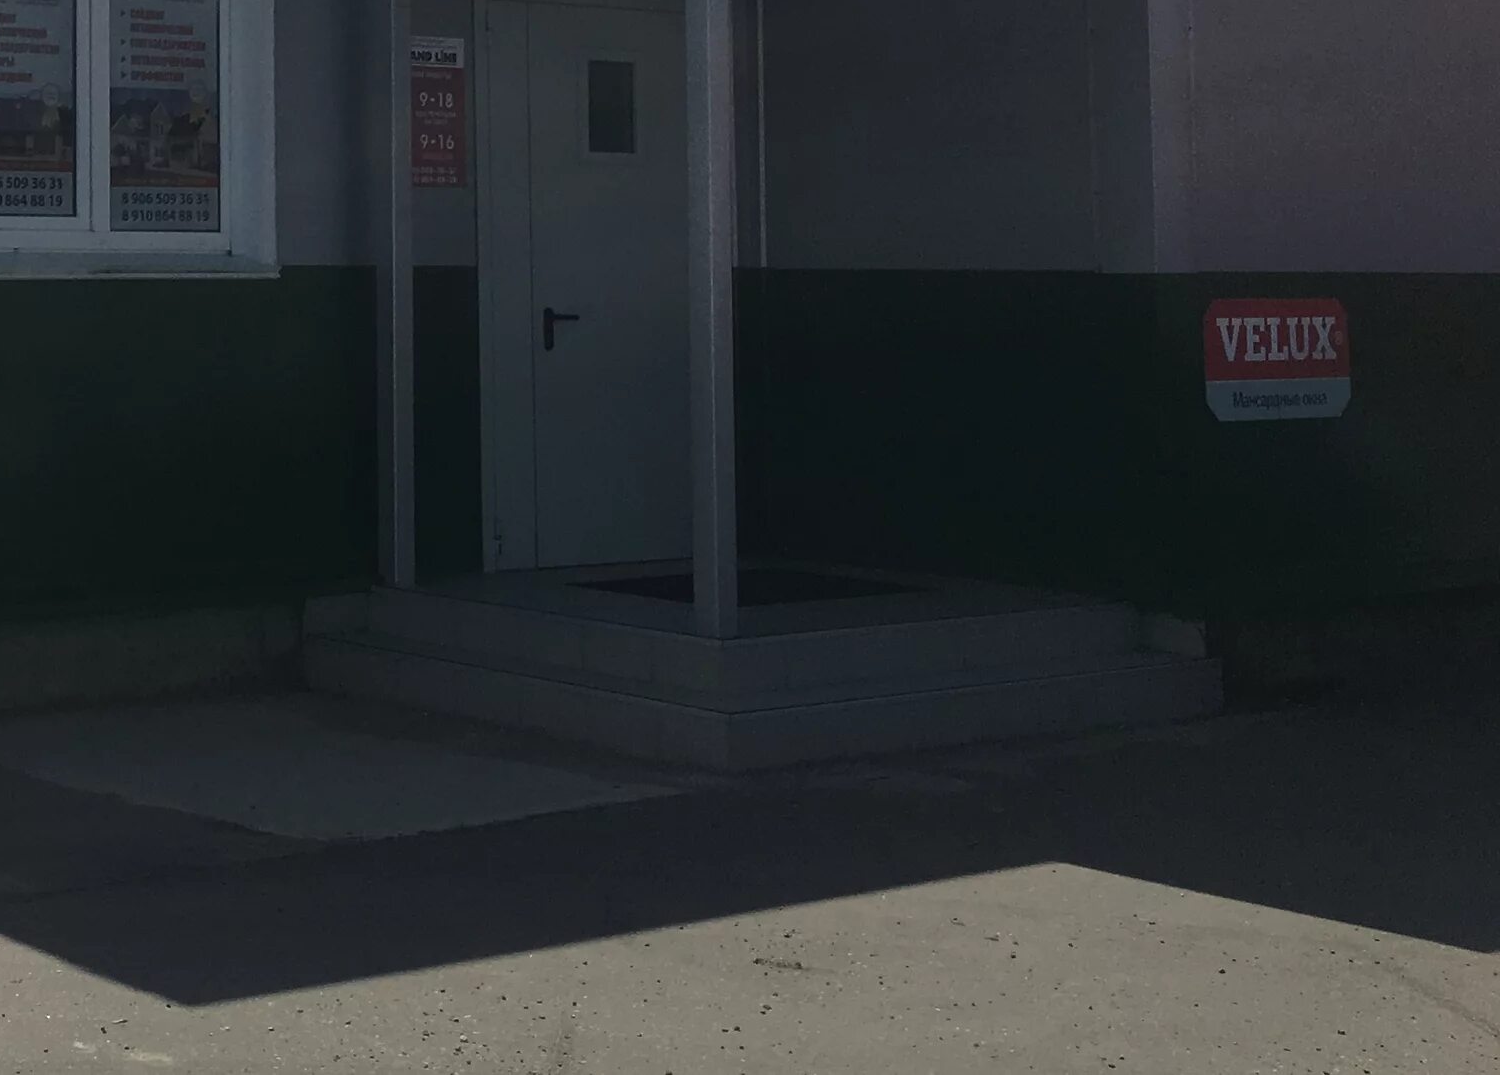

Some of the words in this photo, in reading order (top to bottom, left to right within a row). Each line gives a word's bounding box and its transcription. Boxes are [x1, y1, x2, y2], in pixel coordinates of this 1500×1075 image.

[6, 177, 28, 189] 509
[5, 194, 28, 206] 864
[1215, 316, 1337, 362] VELUX
